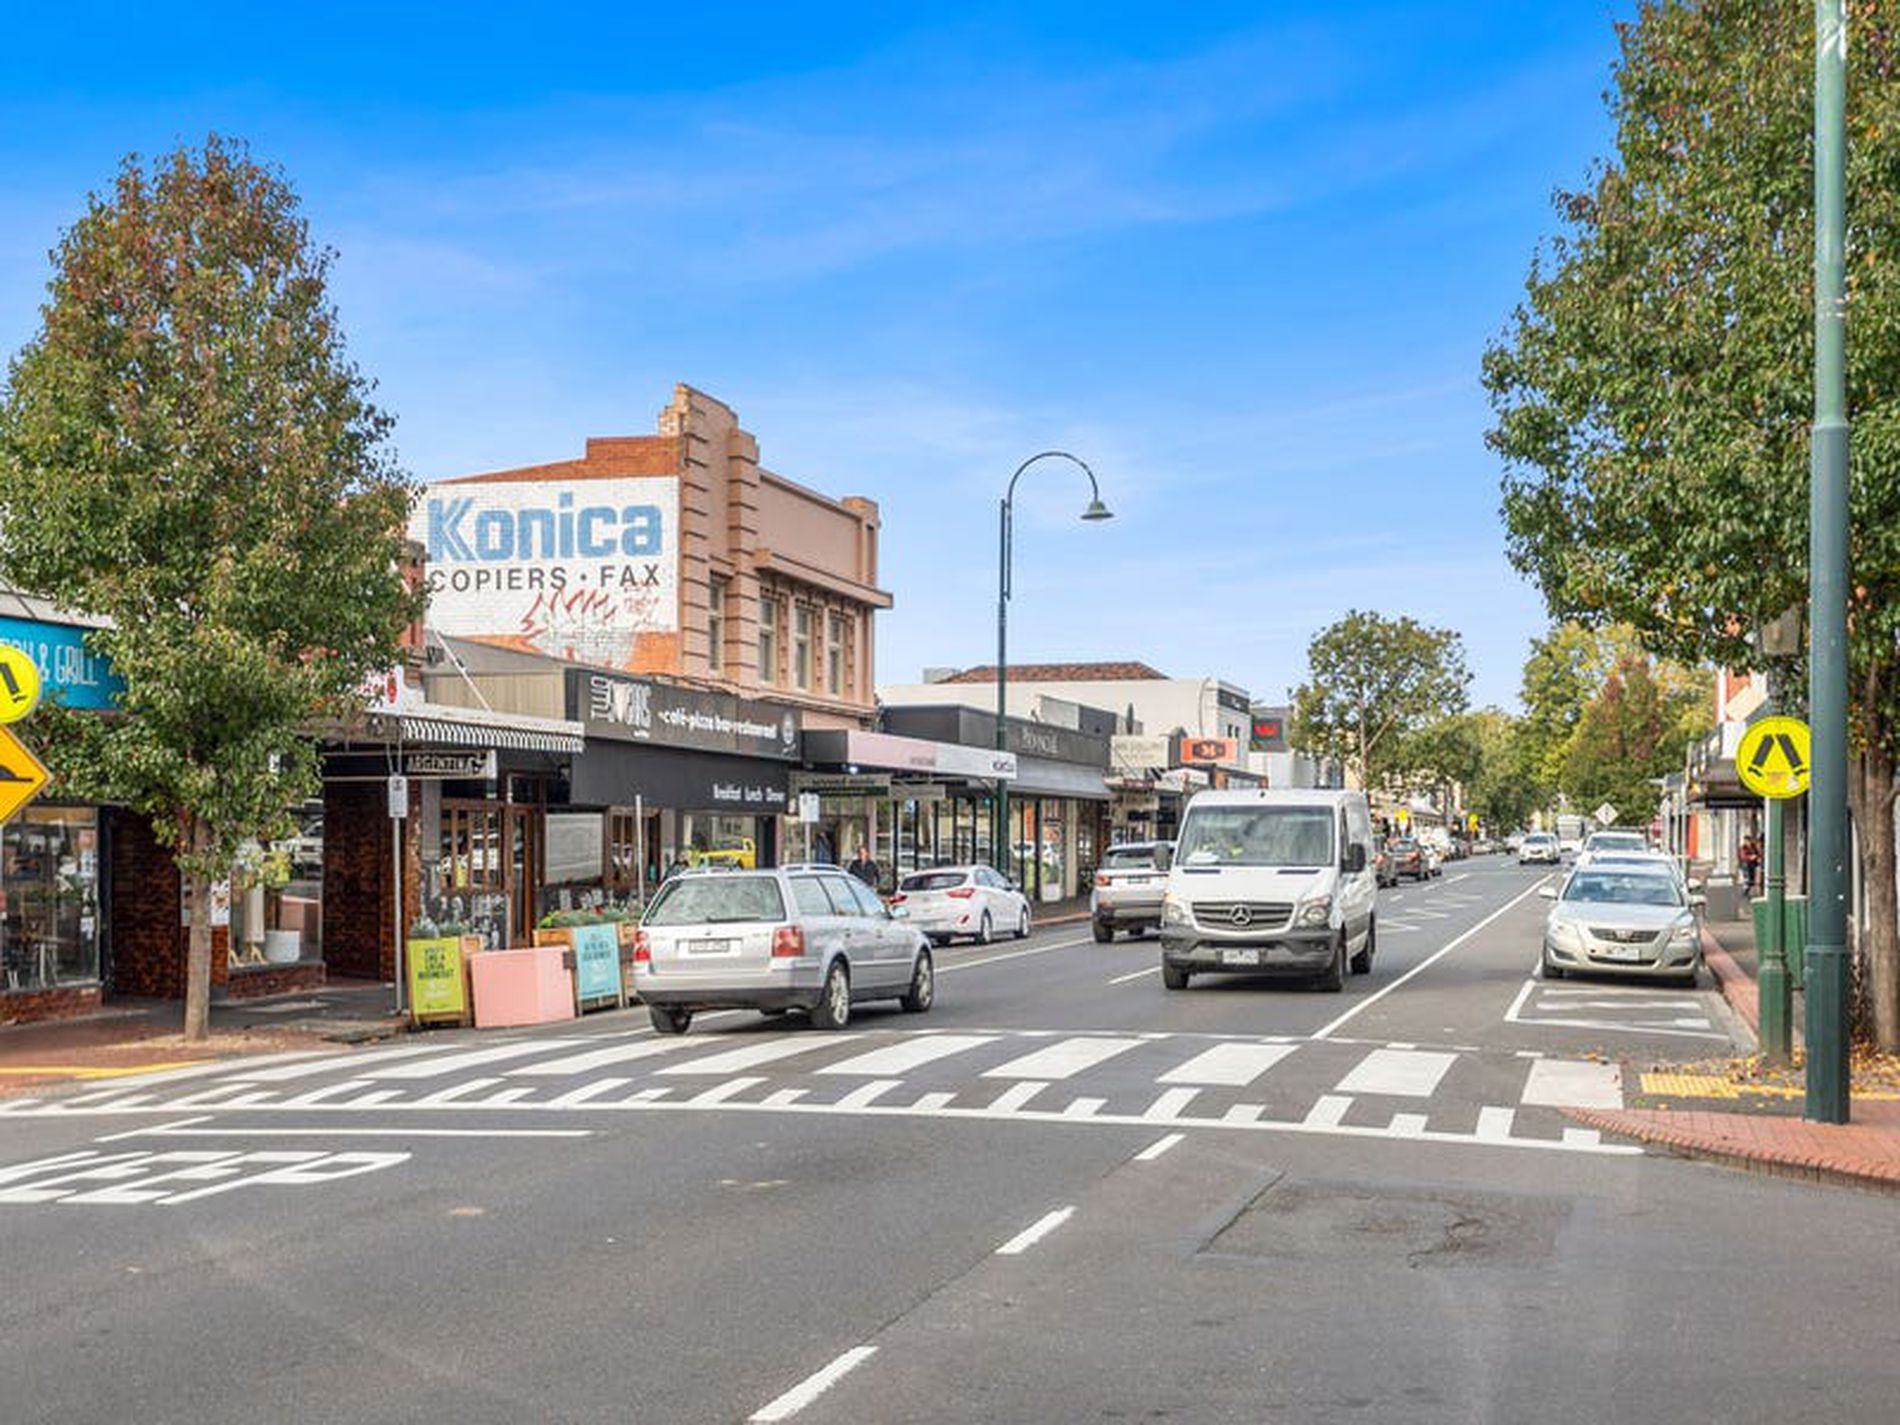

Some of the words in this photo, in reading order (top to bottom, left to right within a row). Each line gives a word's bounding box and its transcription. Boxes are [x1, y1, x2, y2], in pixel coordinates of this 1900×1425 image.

[427, 492, 662, 562] Konica
[430, 566, 567, 592] COPIERS
[600, 564, 660, 587] FAX
[39, 642, 50, 682] &
[54, 645, 98, 685] GRILL
